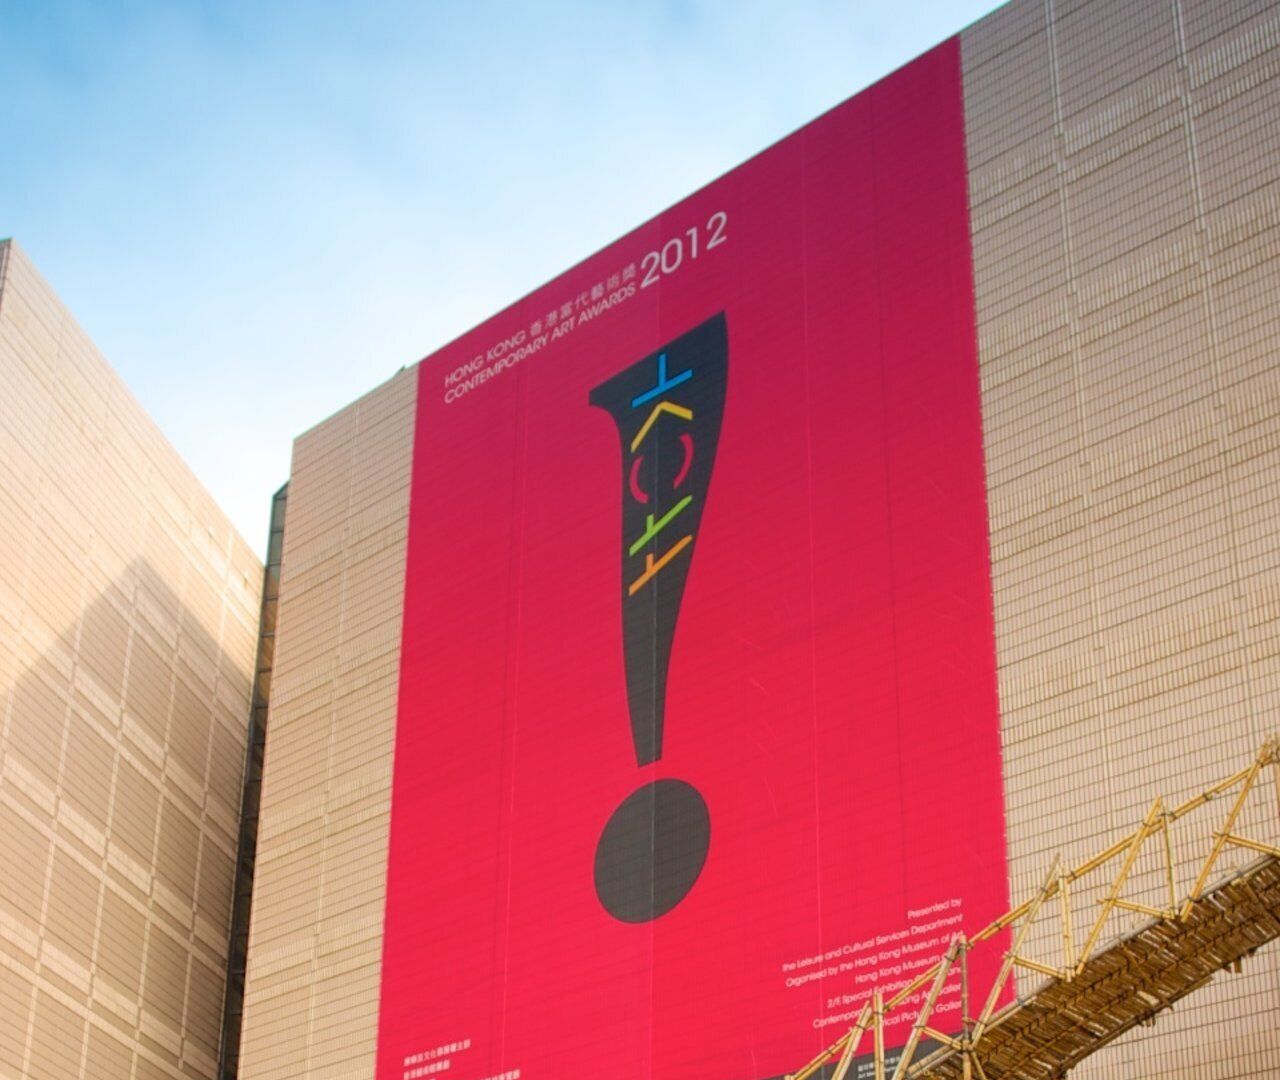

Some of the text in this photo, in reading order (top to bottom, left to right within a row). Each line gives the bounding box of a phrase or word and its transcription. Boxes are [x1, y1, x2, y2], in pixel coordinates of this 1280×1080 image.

[639, 211, 728, 289] 2012
[443, 281, 637, 404] CONTEMPORARY ART AWARDS
[443, 351, 484, 388] HONG
[486, 330, 527, 363] KONG
[908, 898, 962, 919] Presented by
[782, 913, 963, 972] the Leisure and Cultural Services Department
[840, 961, 853, 972] the
[855, 954, 878, 969] Hong
[879, 946, 901, 961] Kong
[902, 937, 940, 955] Museum
